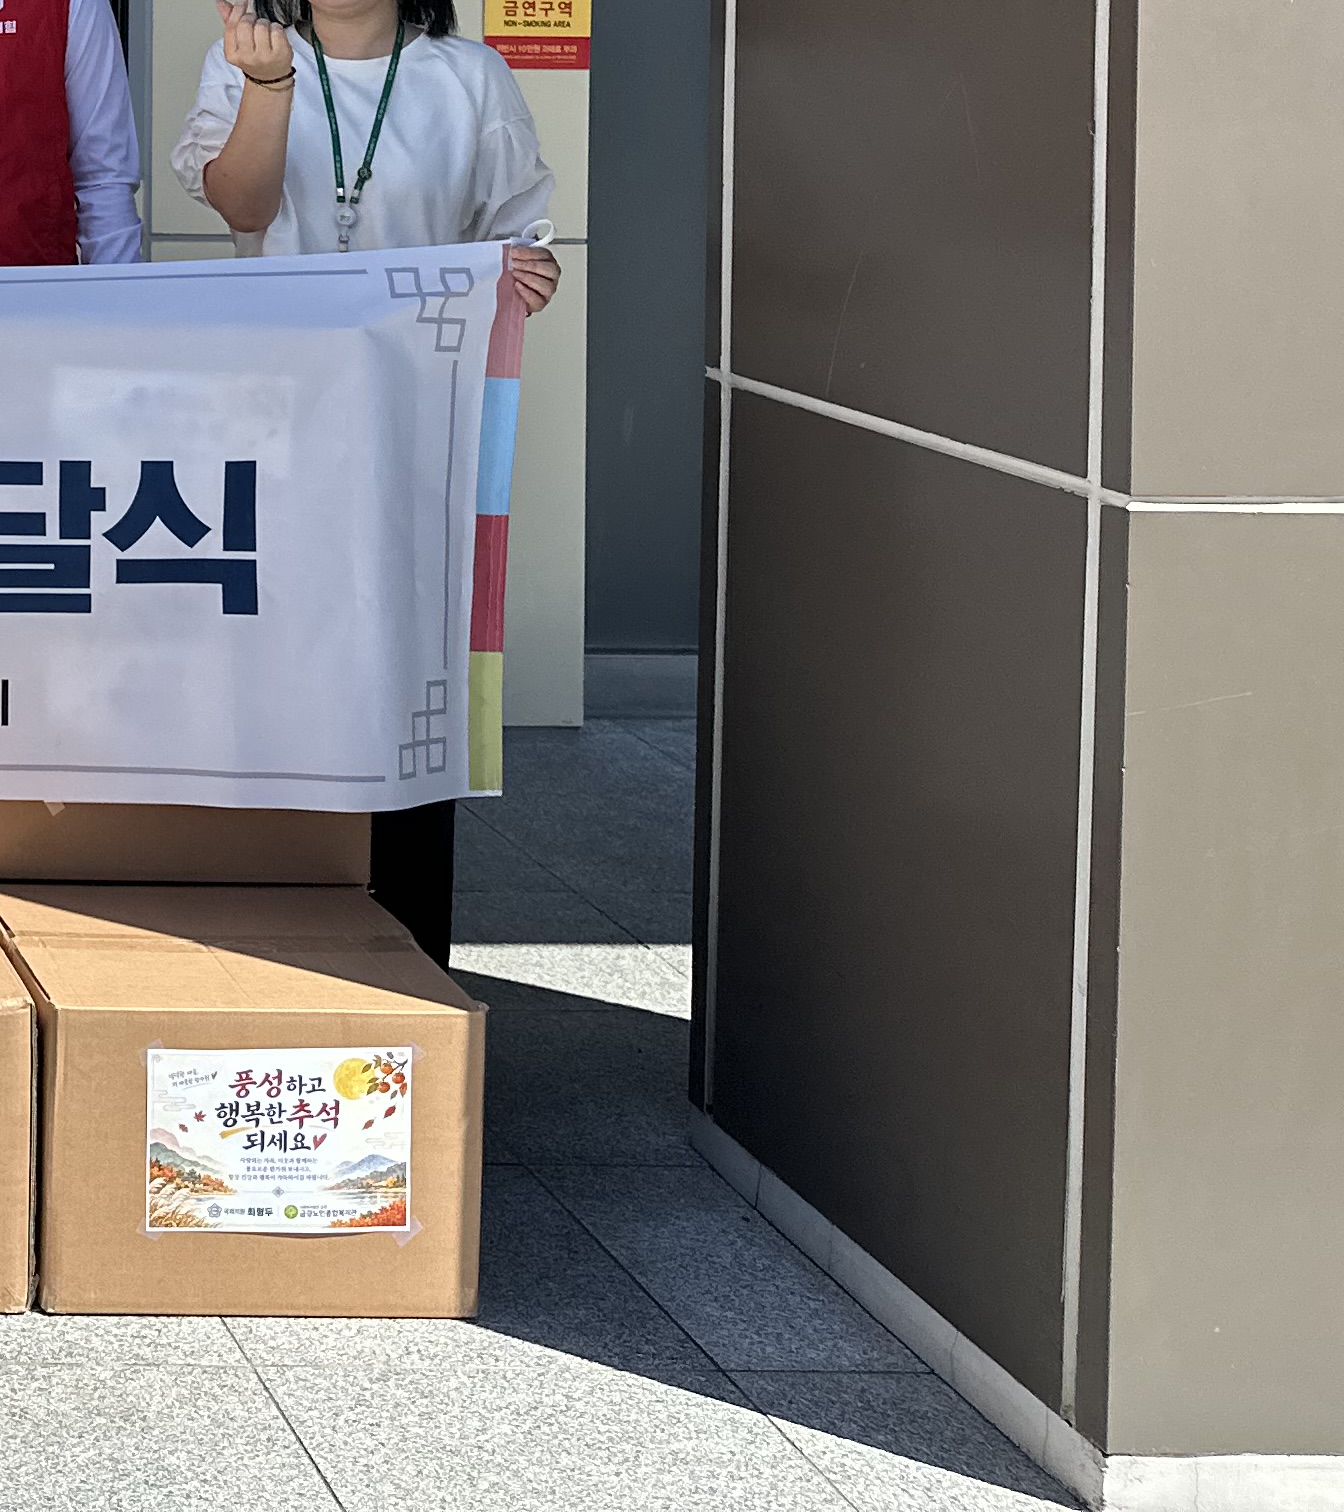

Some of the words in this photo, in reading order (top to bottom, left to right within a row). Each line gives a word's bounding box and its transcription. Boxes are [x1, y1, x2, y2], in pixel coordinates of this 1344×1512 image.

[503, 0, 572, 17] 금연구역
[553, 20, 570, 28] AREA
[228, 1069, 326, 1098] 풍성하고
[243, 1131, 311, 1153] 되세요
